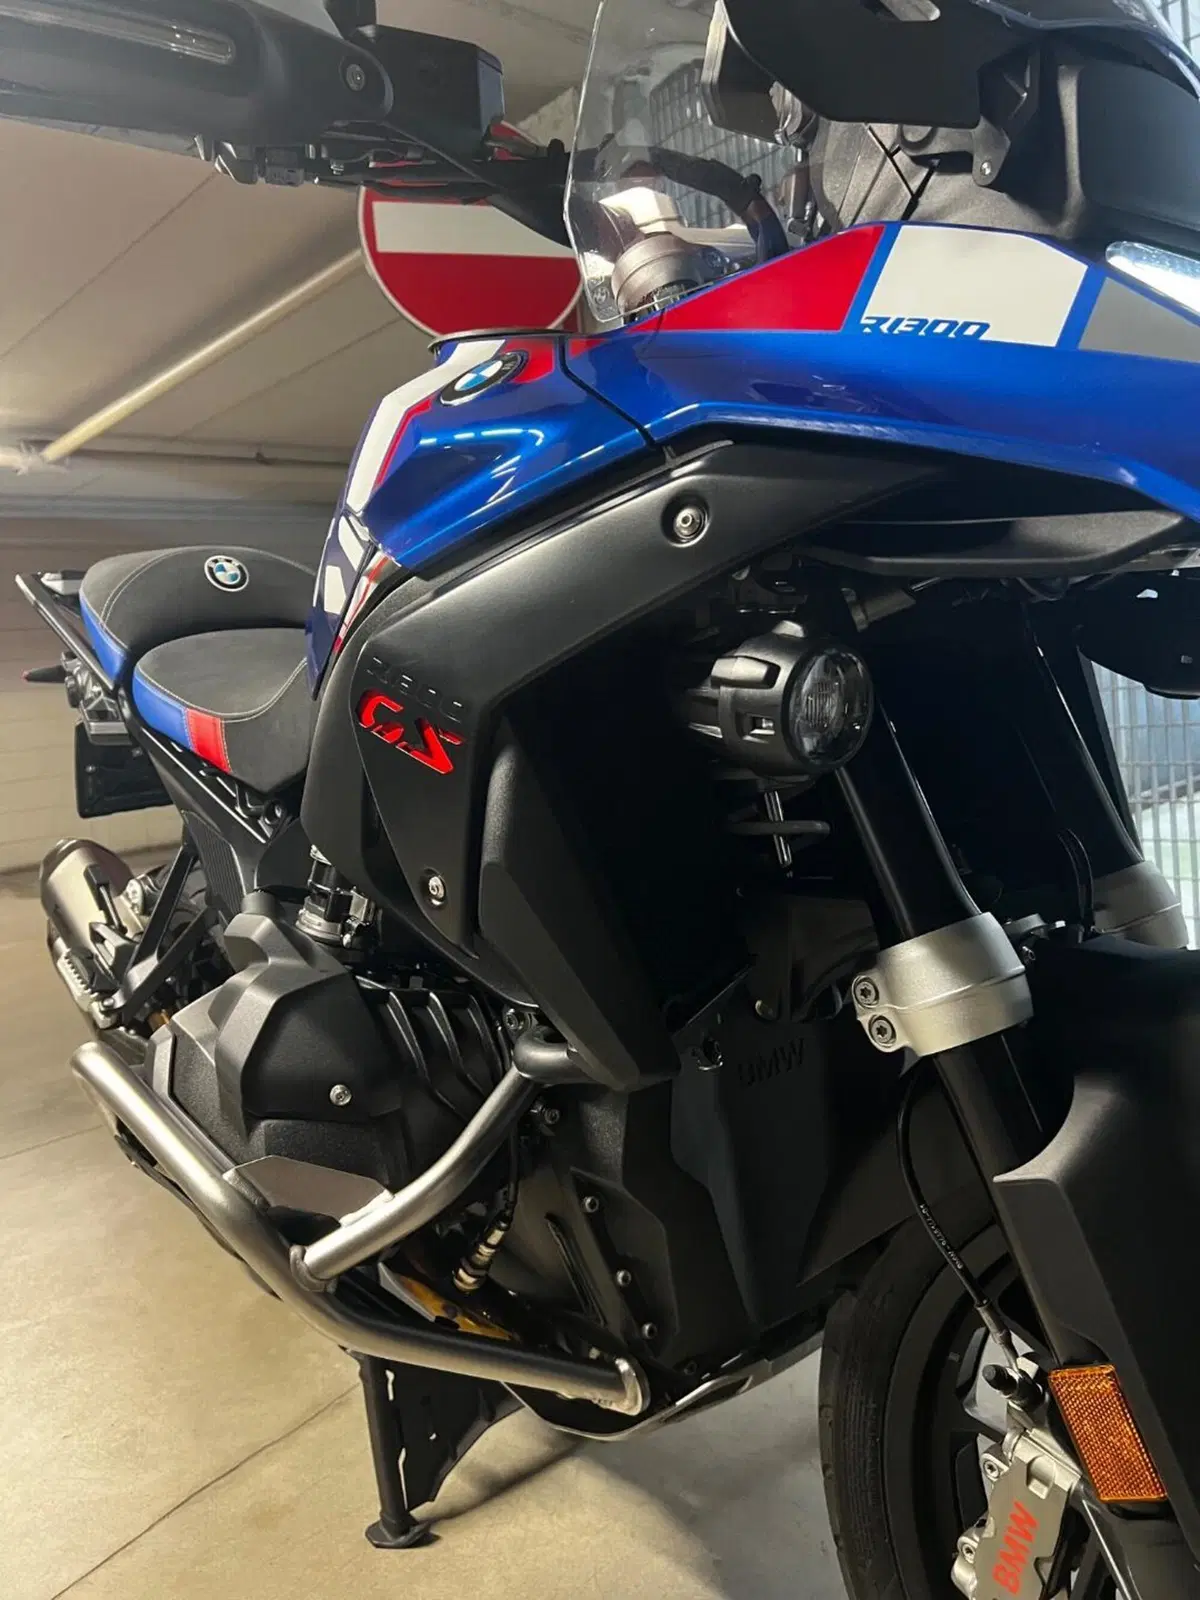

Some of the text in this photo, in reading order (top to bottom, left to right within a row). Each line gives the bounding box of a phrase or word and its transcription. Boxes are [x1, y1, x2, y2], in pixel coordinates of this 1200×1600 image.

[861, 316, 990, 340] R1300
[356, 689, 465, 775] GS
[992, 1500, 1038, 1595] BMW
